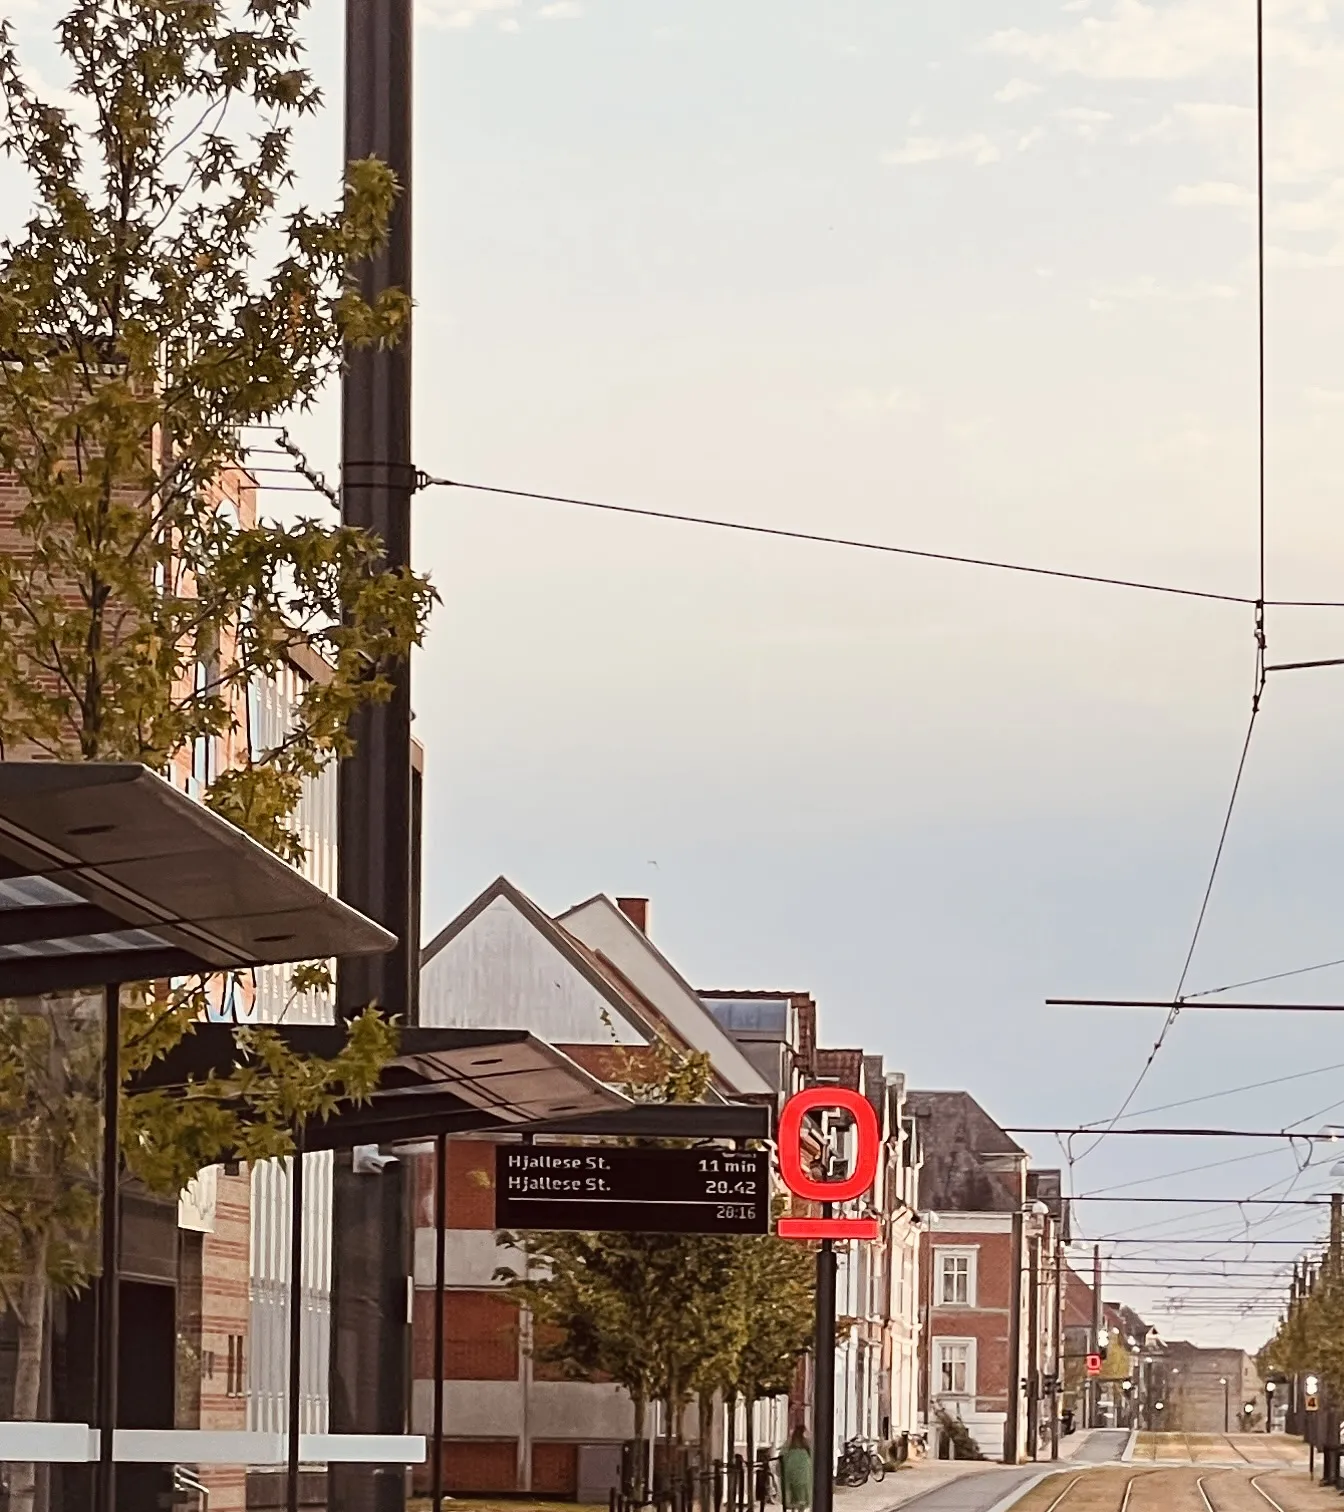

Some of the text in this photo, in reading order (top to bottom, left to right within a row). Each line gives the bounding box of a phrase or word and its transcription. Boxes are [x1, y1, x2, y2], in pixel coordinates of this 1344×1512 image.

[508, 1155, 757, 1173] Hjallese St. 11 min
[508, 1176, 757, 1195] Hjallese St. 20.42
[716, 1206, 756, 1220] 20:16
